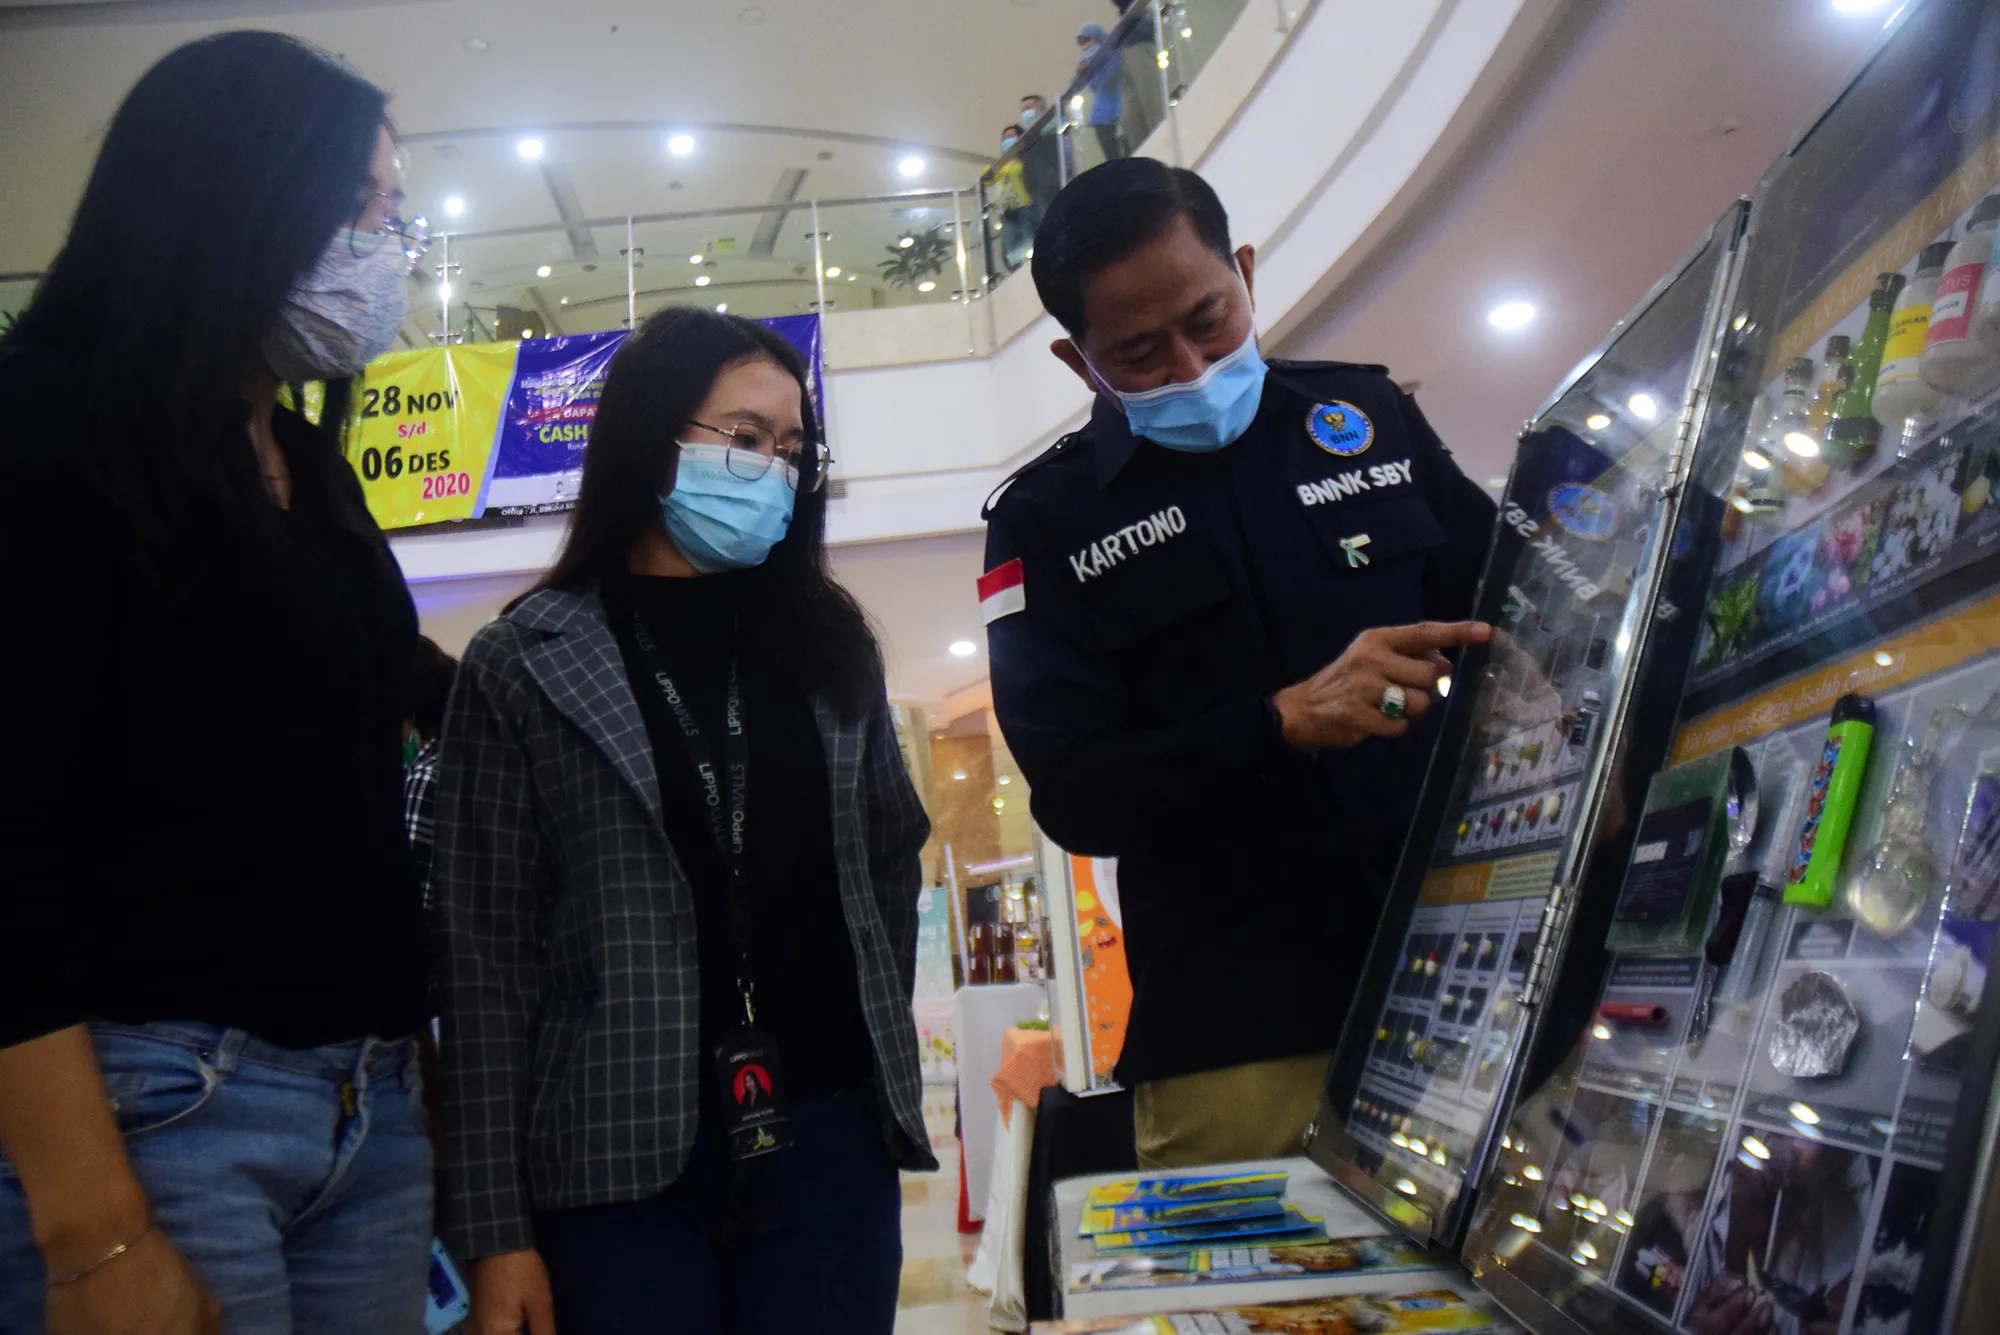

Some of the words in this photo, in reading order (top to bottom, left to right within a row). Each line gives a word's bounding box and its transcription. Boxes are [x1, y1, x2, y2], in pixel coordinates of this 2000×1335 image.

[361, 385, 401, 419] 28
[407, 390, 459, 415] NOV
[539, 424, 588, 443] CASH
[1330, 430, 1360, 445] BNN
[361, 446, 404, 481] 06
[408, 449, 451, 475] DES
[422, 472, 471, 501] 2020
[1296, 469, 1371, 506] BNNK
[1368, 458, 1412, 487] SBY
[1069, 505, 1187, 583] KARTONO
[655, 671, 700, 737] LIPPOMALLS
[731, 763, 745, 854] LIPPOMALLS
